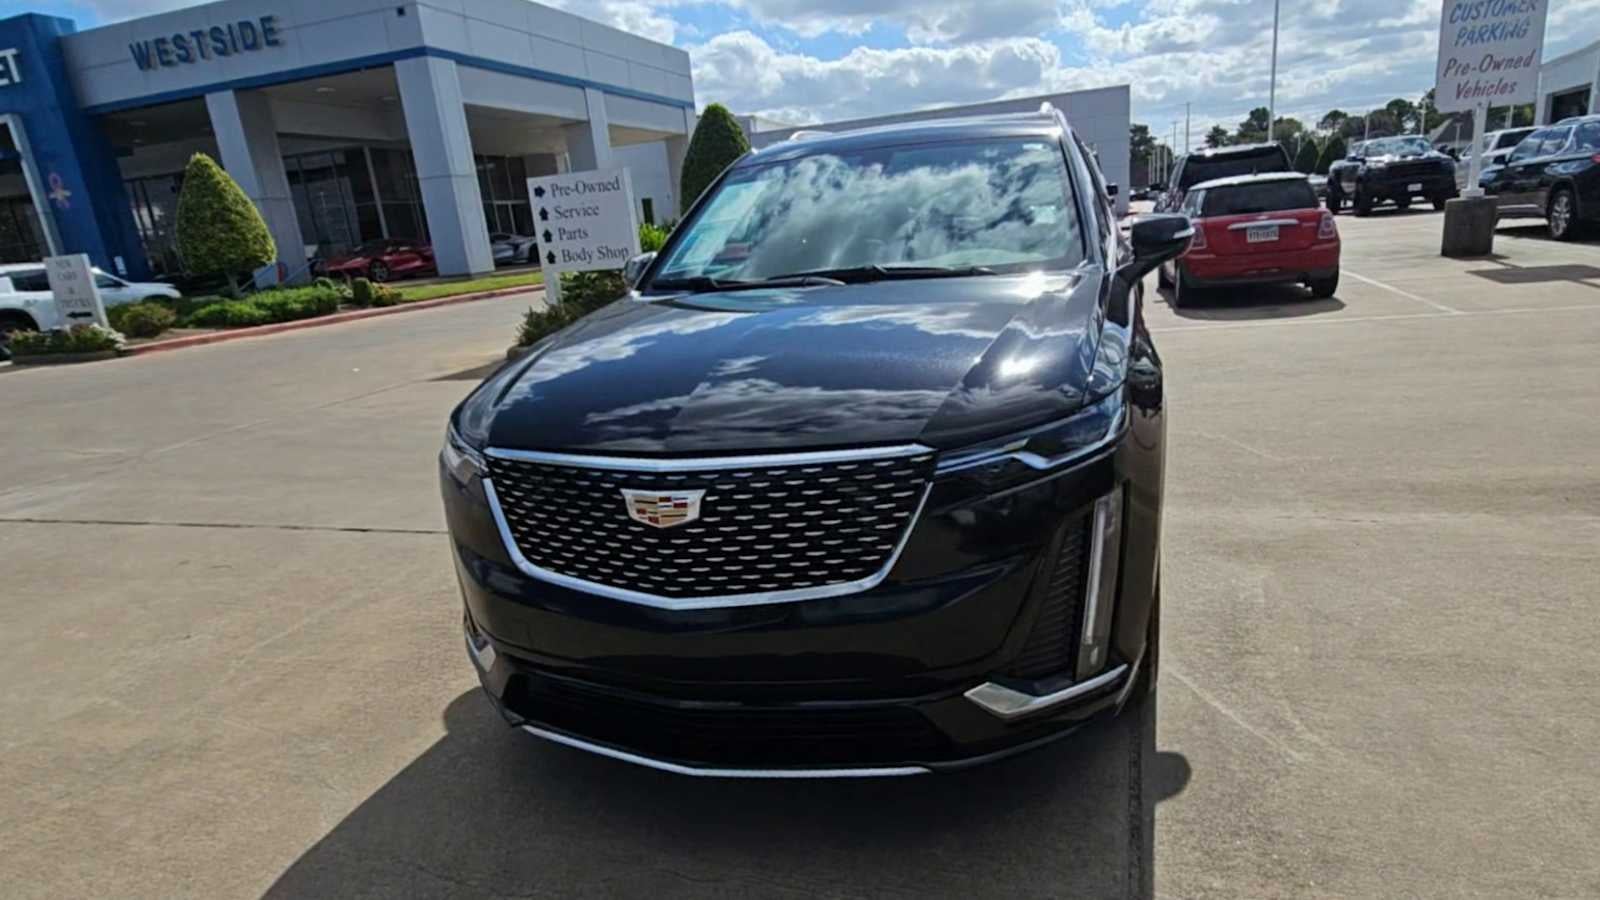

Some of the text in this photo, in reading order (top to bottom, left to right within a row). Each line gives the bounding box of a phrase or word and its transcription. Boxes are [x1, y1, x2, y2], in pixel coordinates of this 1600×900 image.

[1449, 0, 1535, 24] CUSTOMER
[129, 15, 281, 71] WESTSIDE
[1454, 20, 1530, 48] PARKING
[1443, 50, 1536, 78] Pre-Owned
[1455, 77, 1518, 100] Vehicles
[551, 176, 620, 198] Pre-Owned
[554, 204, 600, 219] Service
[557, 227, 589, 241] Parts
[562, 245, 630, 264] Body Shop
